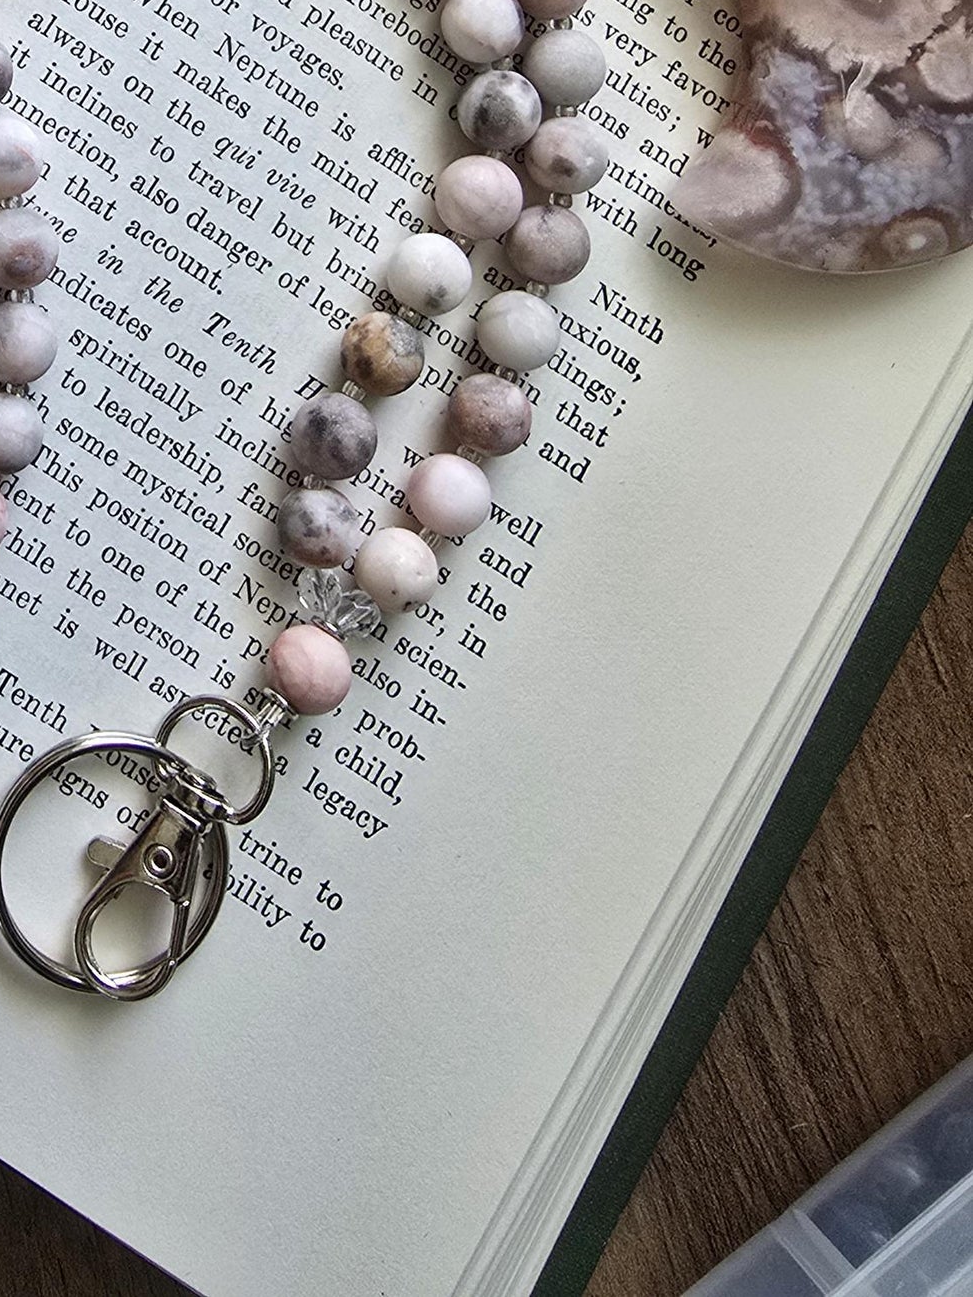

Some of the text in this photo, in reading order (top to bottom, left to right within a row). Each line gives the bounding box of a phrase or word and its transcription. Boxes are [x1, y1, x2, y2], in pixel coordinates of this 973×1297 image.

[27, 13, 380, 255] always the qui vive with
[172, 58, 252, 120] makes
[262, 114, 302, 154] the
[310, 150, 379, 205] mind
[251, 13, 344, 91] voyages.
[299, 4, 404, 82] pleasure
[585, 189, 639, 239] with
[605, 22, 658, 68] very
[638, 138, 690, 179] and
[698, 36, 737, 76] the
[39, 66, 610, 448] inclines travel but that
[63, 174, 223, 296] that account.
[212, 31, 319, 118] Neptune
[588, 281, 664, 345] Ninth
[93, 385, 225, 494] leadership,
[130, 174, 592, 484] also danger and
[143, 275, 544, 548] the Tenth well
[56, 414, 467, 690] some mystical scien-
[67, 328, 507, 622] spiritually the
[164, 341, 534, 589] one and
[65, 567, 404, 807] the person child,
[85, 486, 447, 726] position also in-
[100, 545, 426, 762] one the prob-
[95, 636, 142, 681] well
[301, 766, 389, 839] legacy
[238, 828, 303, 886] trine
